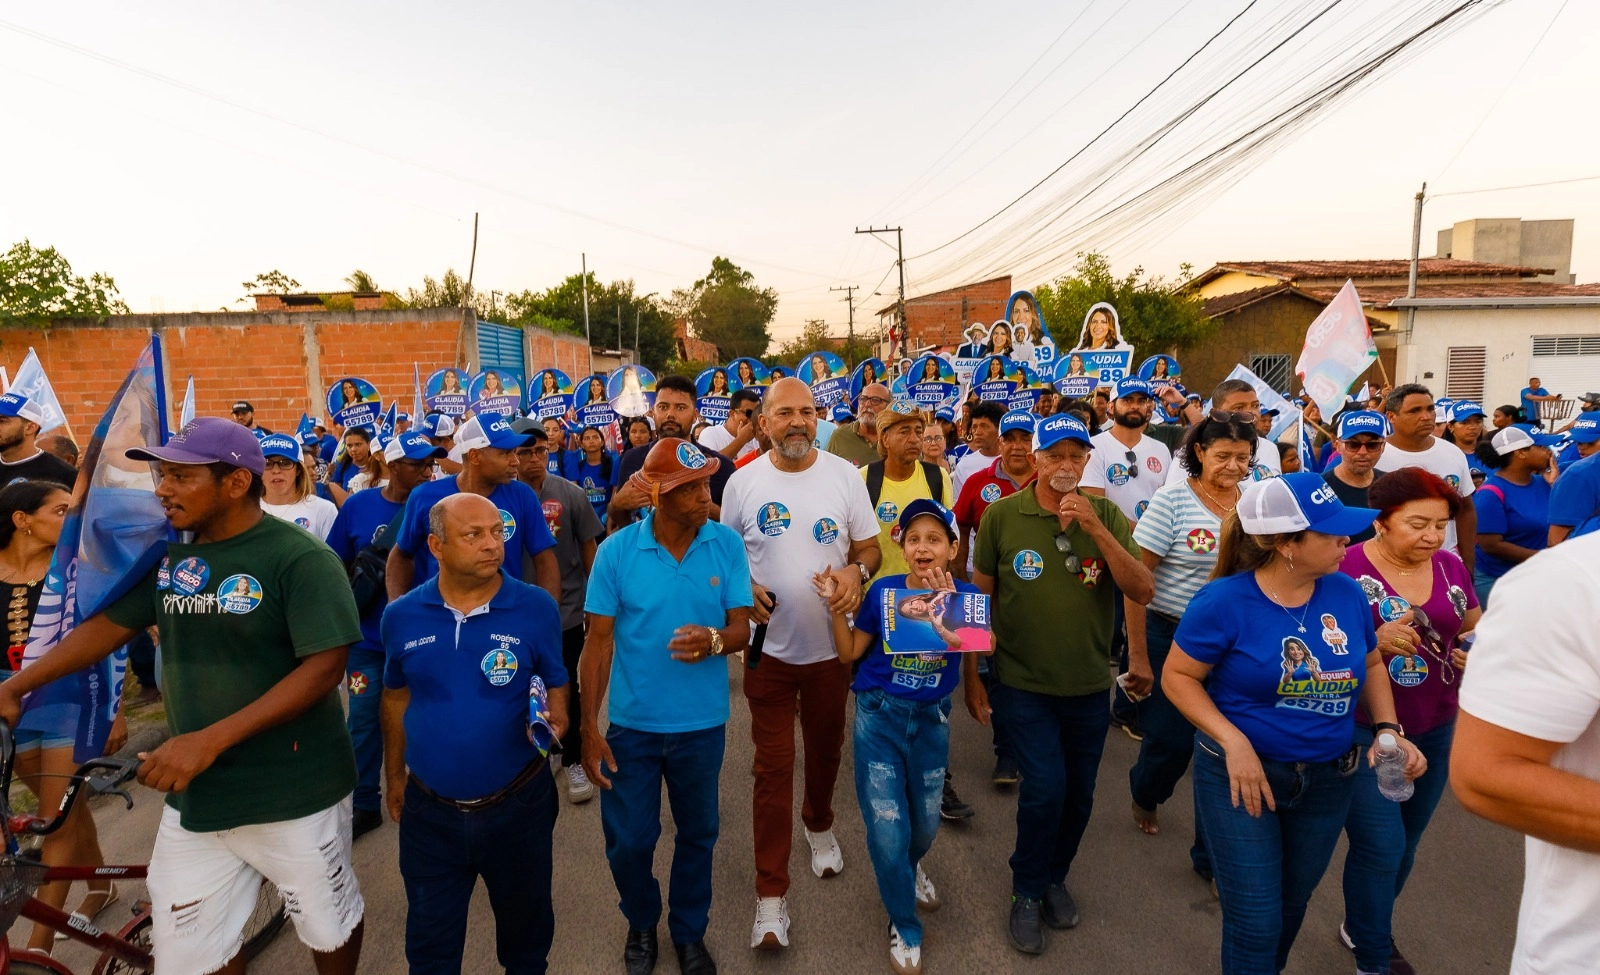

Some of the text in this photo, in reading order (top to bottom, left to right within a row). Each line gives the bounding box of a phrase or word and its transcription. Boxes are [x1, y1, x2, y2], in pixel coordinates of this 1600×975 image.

[1010, 400, 1033, 410] 55789
[341, 406, 371, 417] CLAUDIA
[345, 415, 373, 427] 55789
[586, 415, 612, 424] 55789
[1197, 536, 1205, 545] 13
[1089, 568, 1097, 577] 13
[976, 595, 985, 621] 55789
[490, 634, 520, 645] ROBÉRIO
[895, 659, 942, 671] CLAUDIA
[1281, 681, 1353, 693] CLAUDIA
[1284, 699, 1347, 714] 55789
[95, 867, 129, 875] WENDY
[68, 916, 105, 938] WENDY
